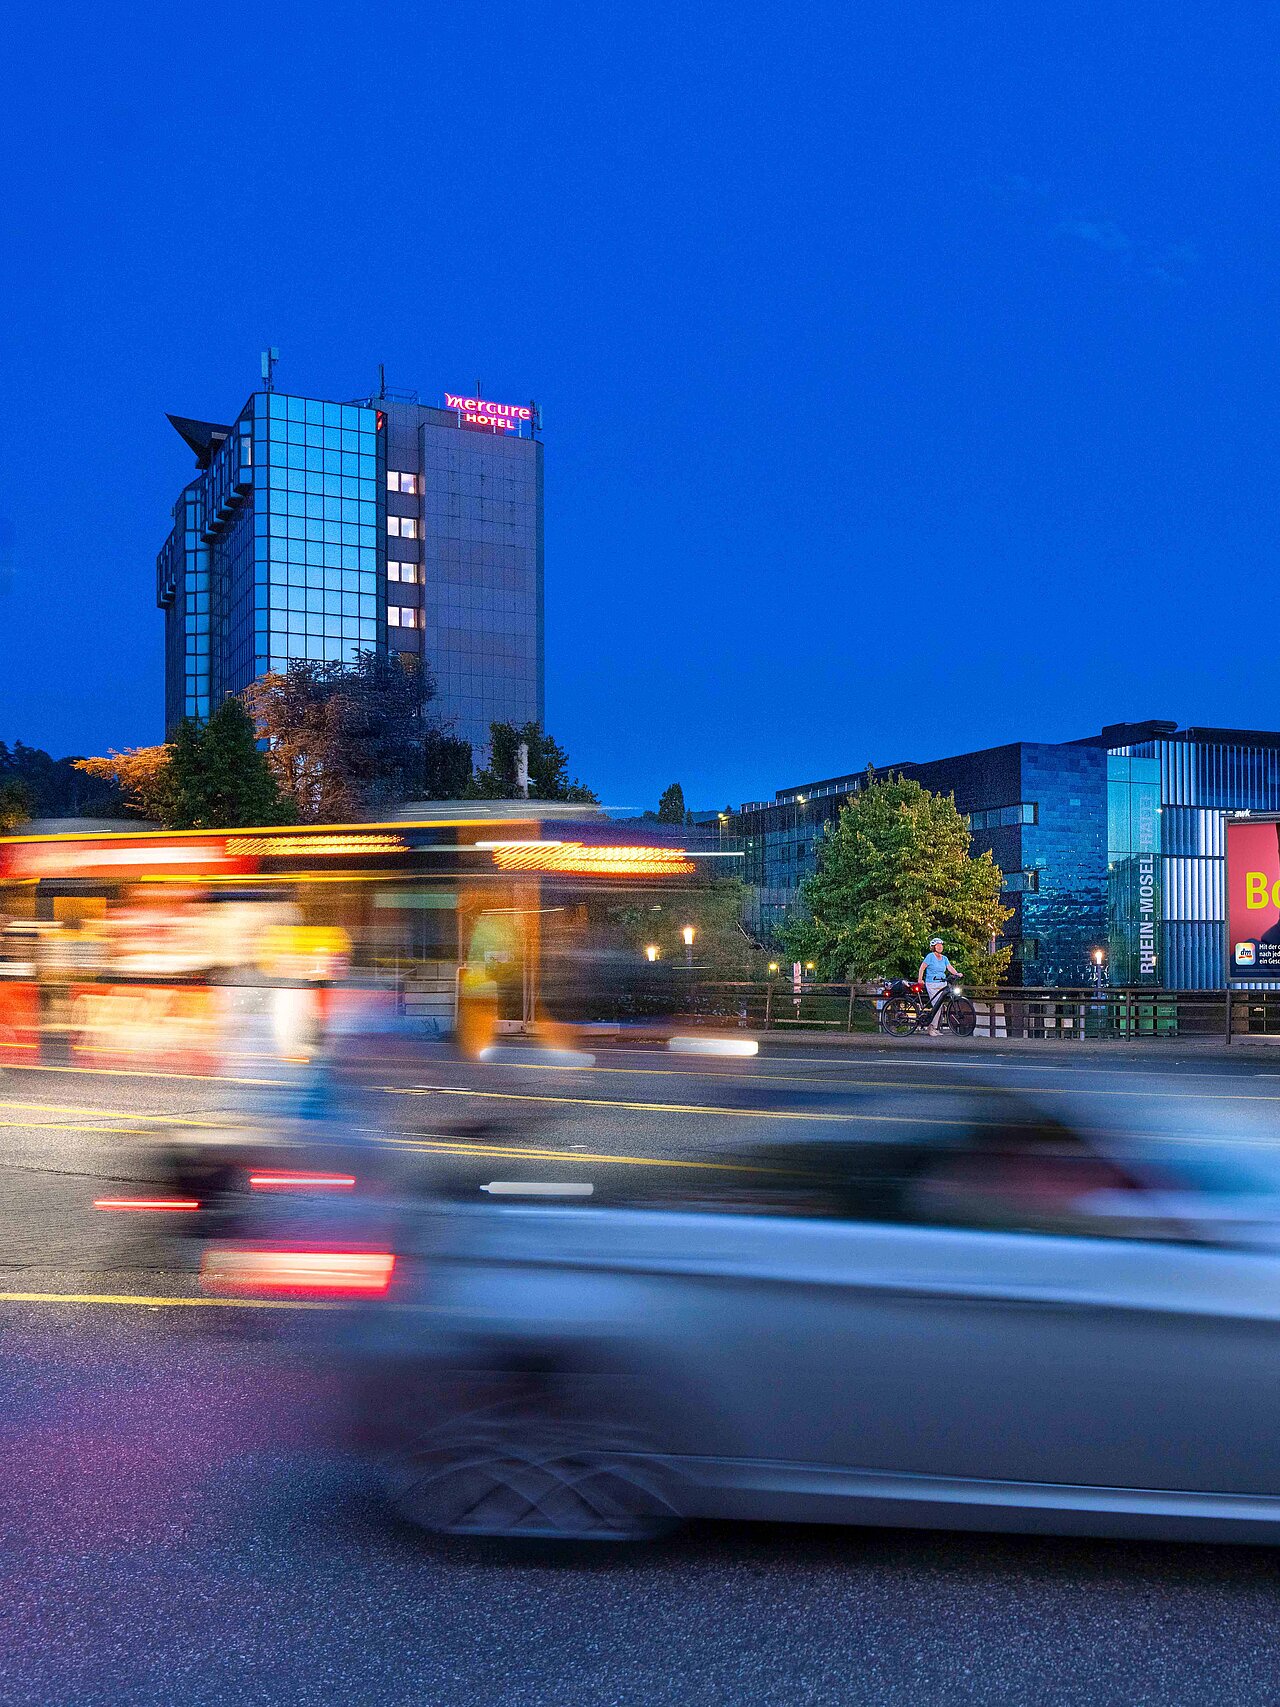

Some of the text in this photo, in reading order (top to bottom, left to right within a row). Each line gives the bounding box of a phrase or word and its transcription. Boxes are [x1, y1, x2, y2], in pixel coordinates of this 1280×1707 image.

[444, 392, 531, 420] mercure
[465, 413, 515, 429] HOTEL
[1234, 808, 1251, 818] awk
